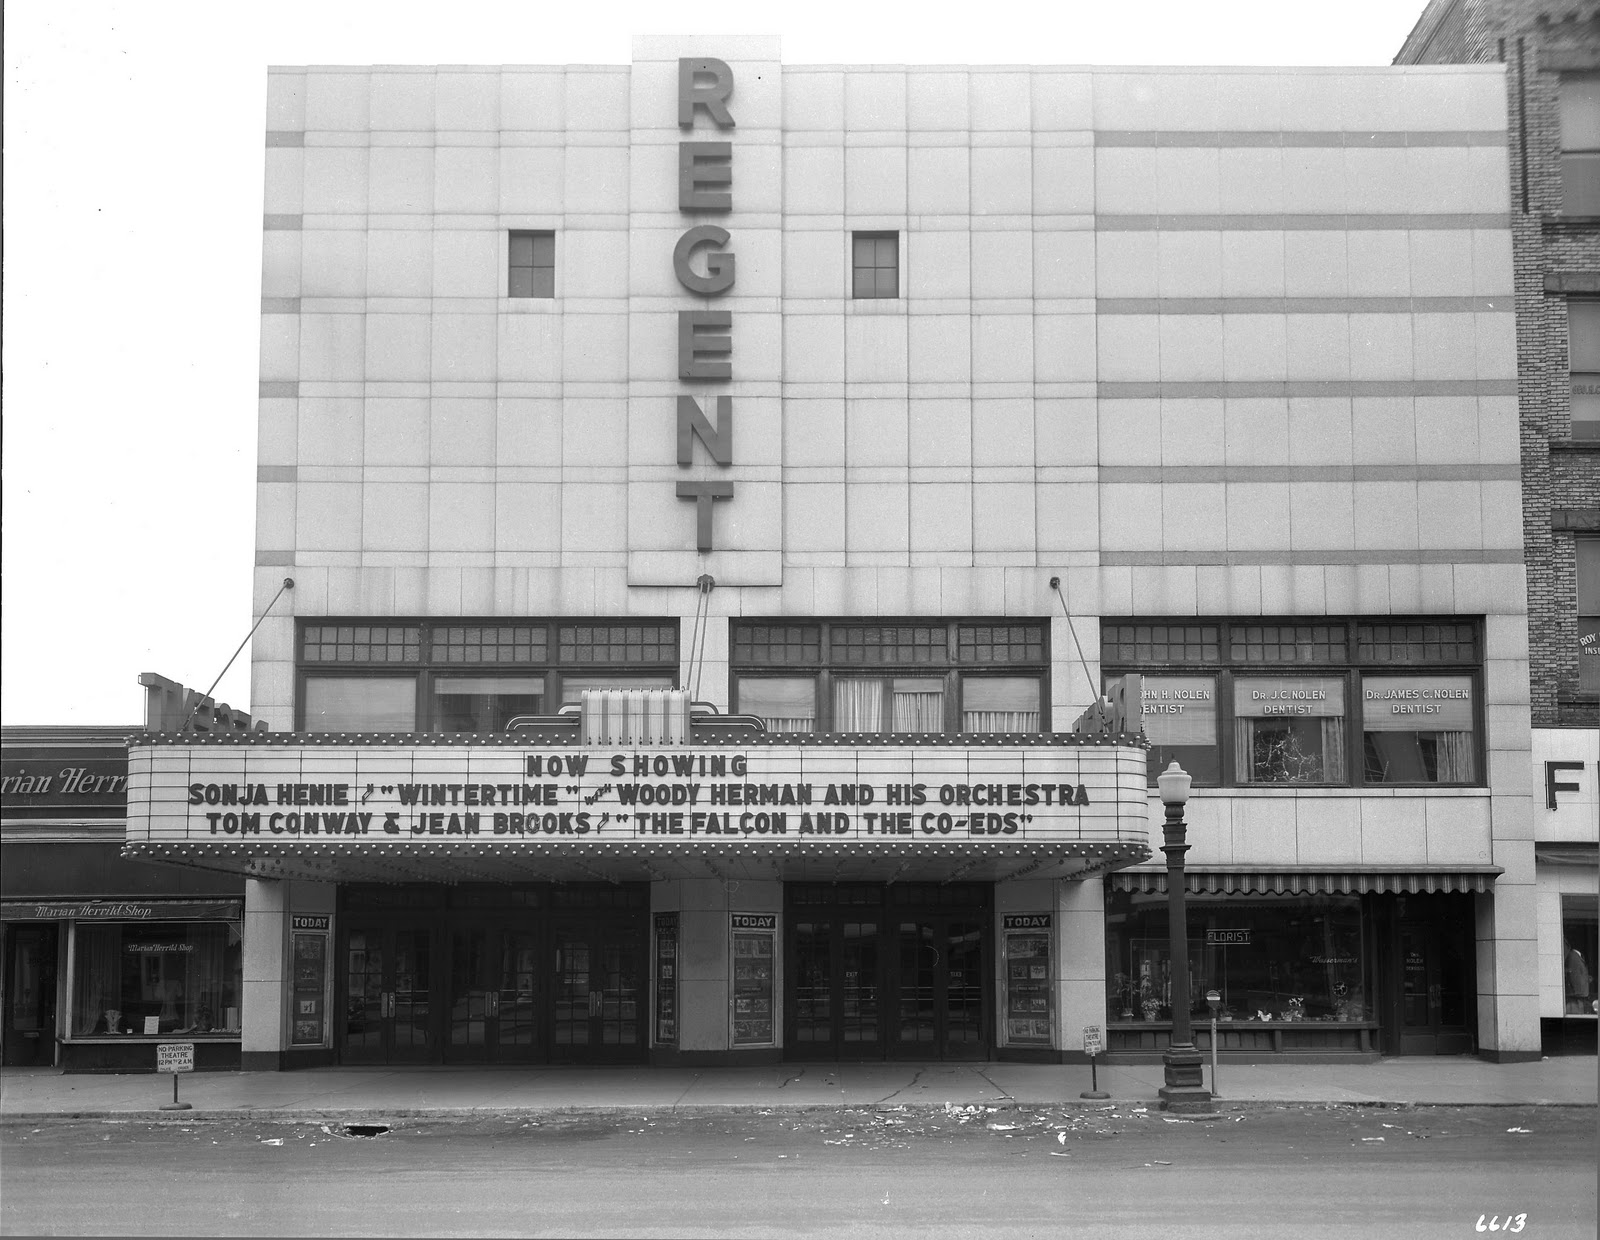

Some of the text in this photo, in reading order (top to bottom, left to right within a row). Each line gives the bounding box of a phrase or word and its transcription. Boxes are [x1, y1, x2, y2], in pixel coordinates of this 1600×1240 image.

[673, 57, 735, 553] REGENT
[1580, 633, 1596, 646] ROY
[1174, 690, 1210, 699] NOLEN
[1292, 690, 1326, 700] NOLEN
[1385, 689, 1419, 699] JAMES
[1434, 689, 1469, 699] NOLEN
[1140, 704, 1185, 714] ENTIST
[1264, 705, 1312, 714] DENTIST
[1392, 704, 1442, 714] DENTIST
[527, 755, 747, 777] NOW SHOWING
[188, 783, 269, 806] SONJA
[277, 783, 349, 806] HENIE
[616, 783, 700, 806] WOODY
[711, 783, 812, 806] HERMAN
[824, 783, 874, 806] AND
[886, 783, 927, 806] HIS
[939, 783, 1090, 806] ORCHESTRA
[206, 812, 261, 834] TOM
[269, 812, 373, 834] CONWAY
[383, 812, 400, 834] &
[411, 812, 480, 834] JEAN
[493, 812, 591, 834] BROOKS
[691, 812, 787, 834] FALCON
[798, 812, 850, 834] AND
[863, 812, 912, 834] THE
[35, 906, 76, 917] Marian
[122, 905, 152, 919] Shop
[293, 917, 328, 928] TODAY
[657, 917, 677, 927] TODAY
[733, 917, 773, 927] TODAY
[1006, 917, 1048, 927] TODAY
[1207, 931, 1250, 942] FLORIST
